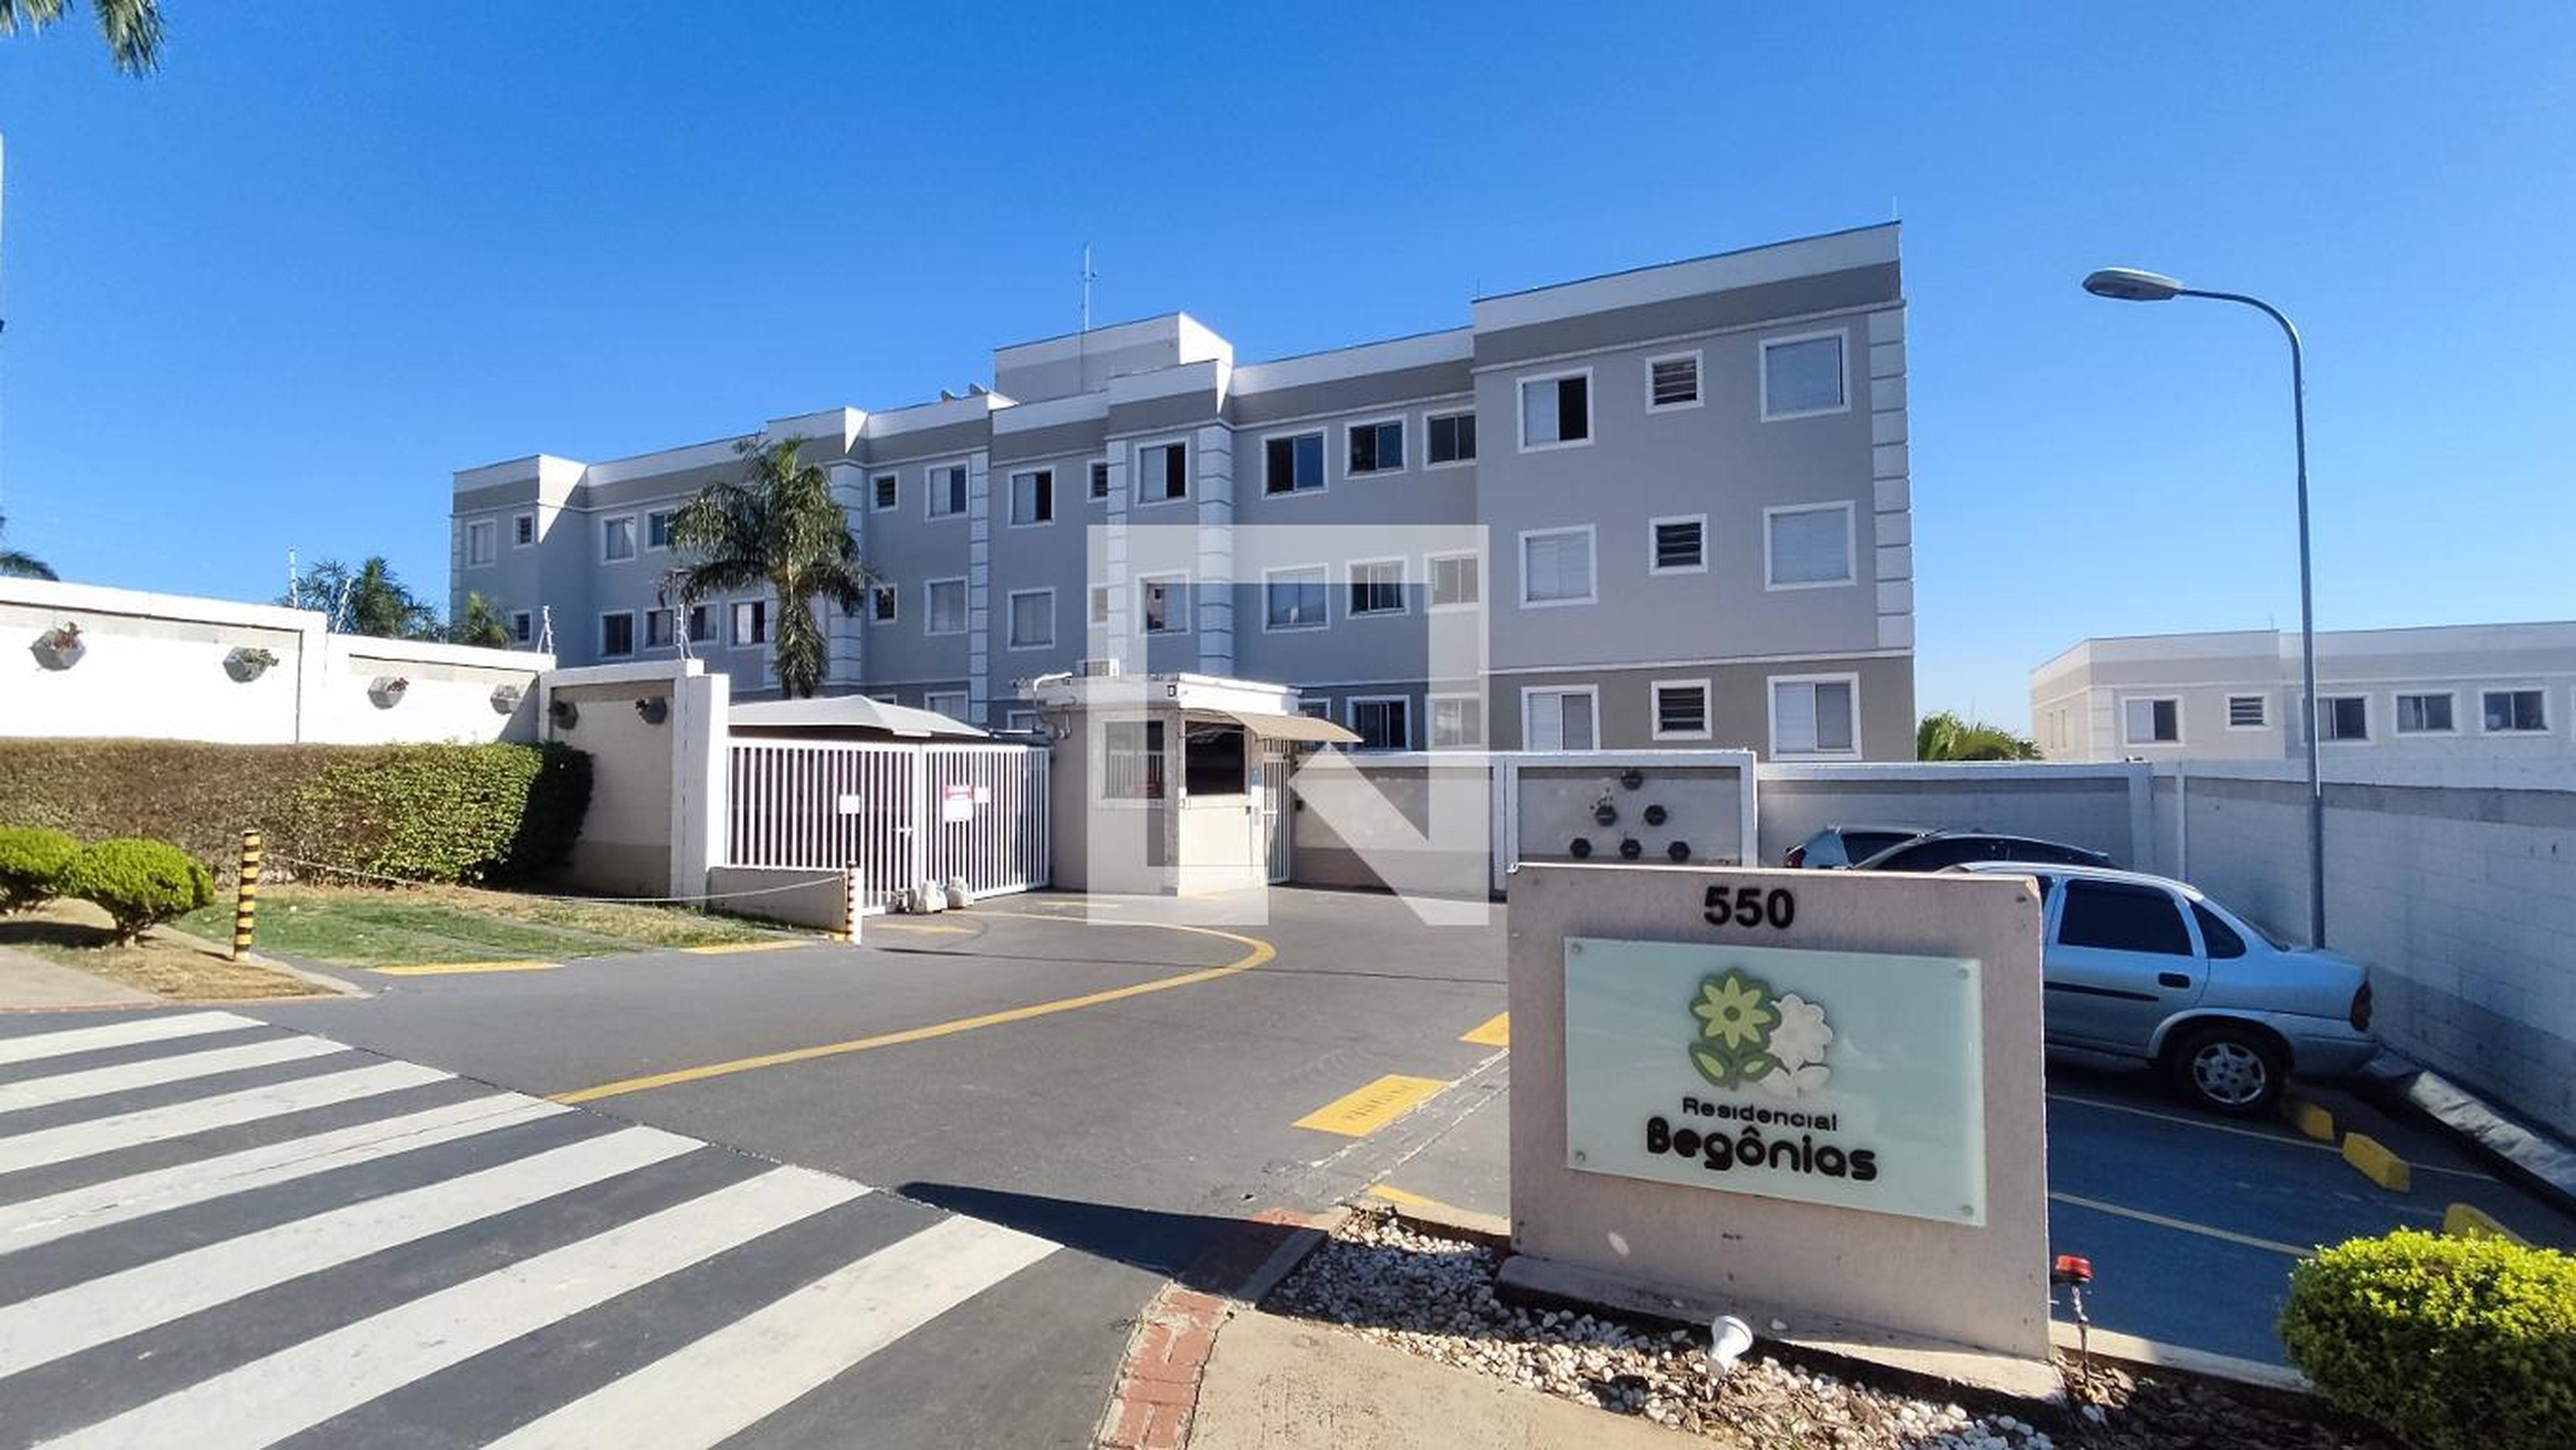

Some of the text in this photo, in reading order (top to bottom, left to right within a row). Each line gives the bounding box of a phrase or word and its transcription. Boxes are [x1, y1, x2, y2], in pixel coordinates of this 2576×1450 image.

[1703, 885, 1796, 931] 550
[1682, 1096, 1837, 1132] Residencial
[1646, 1116, 1878, 1182] Begônias
